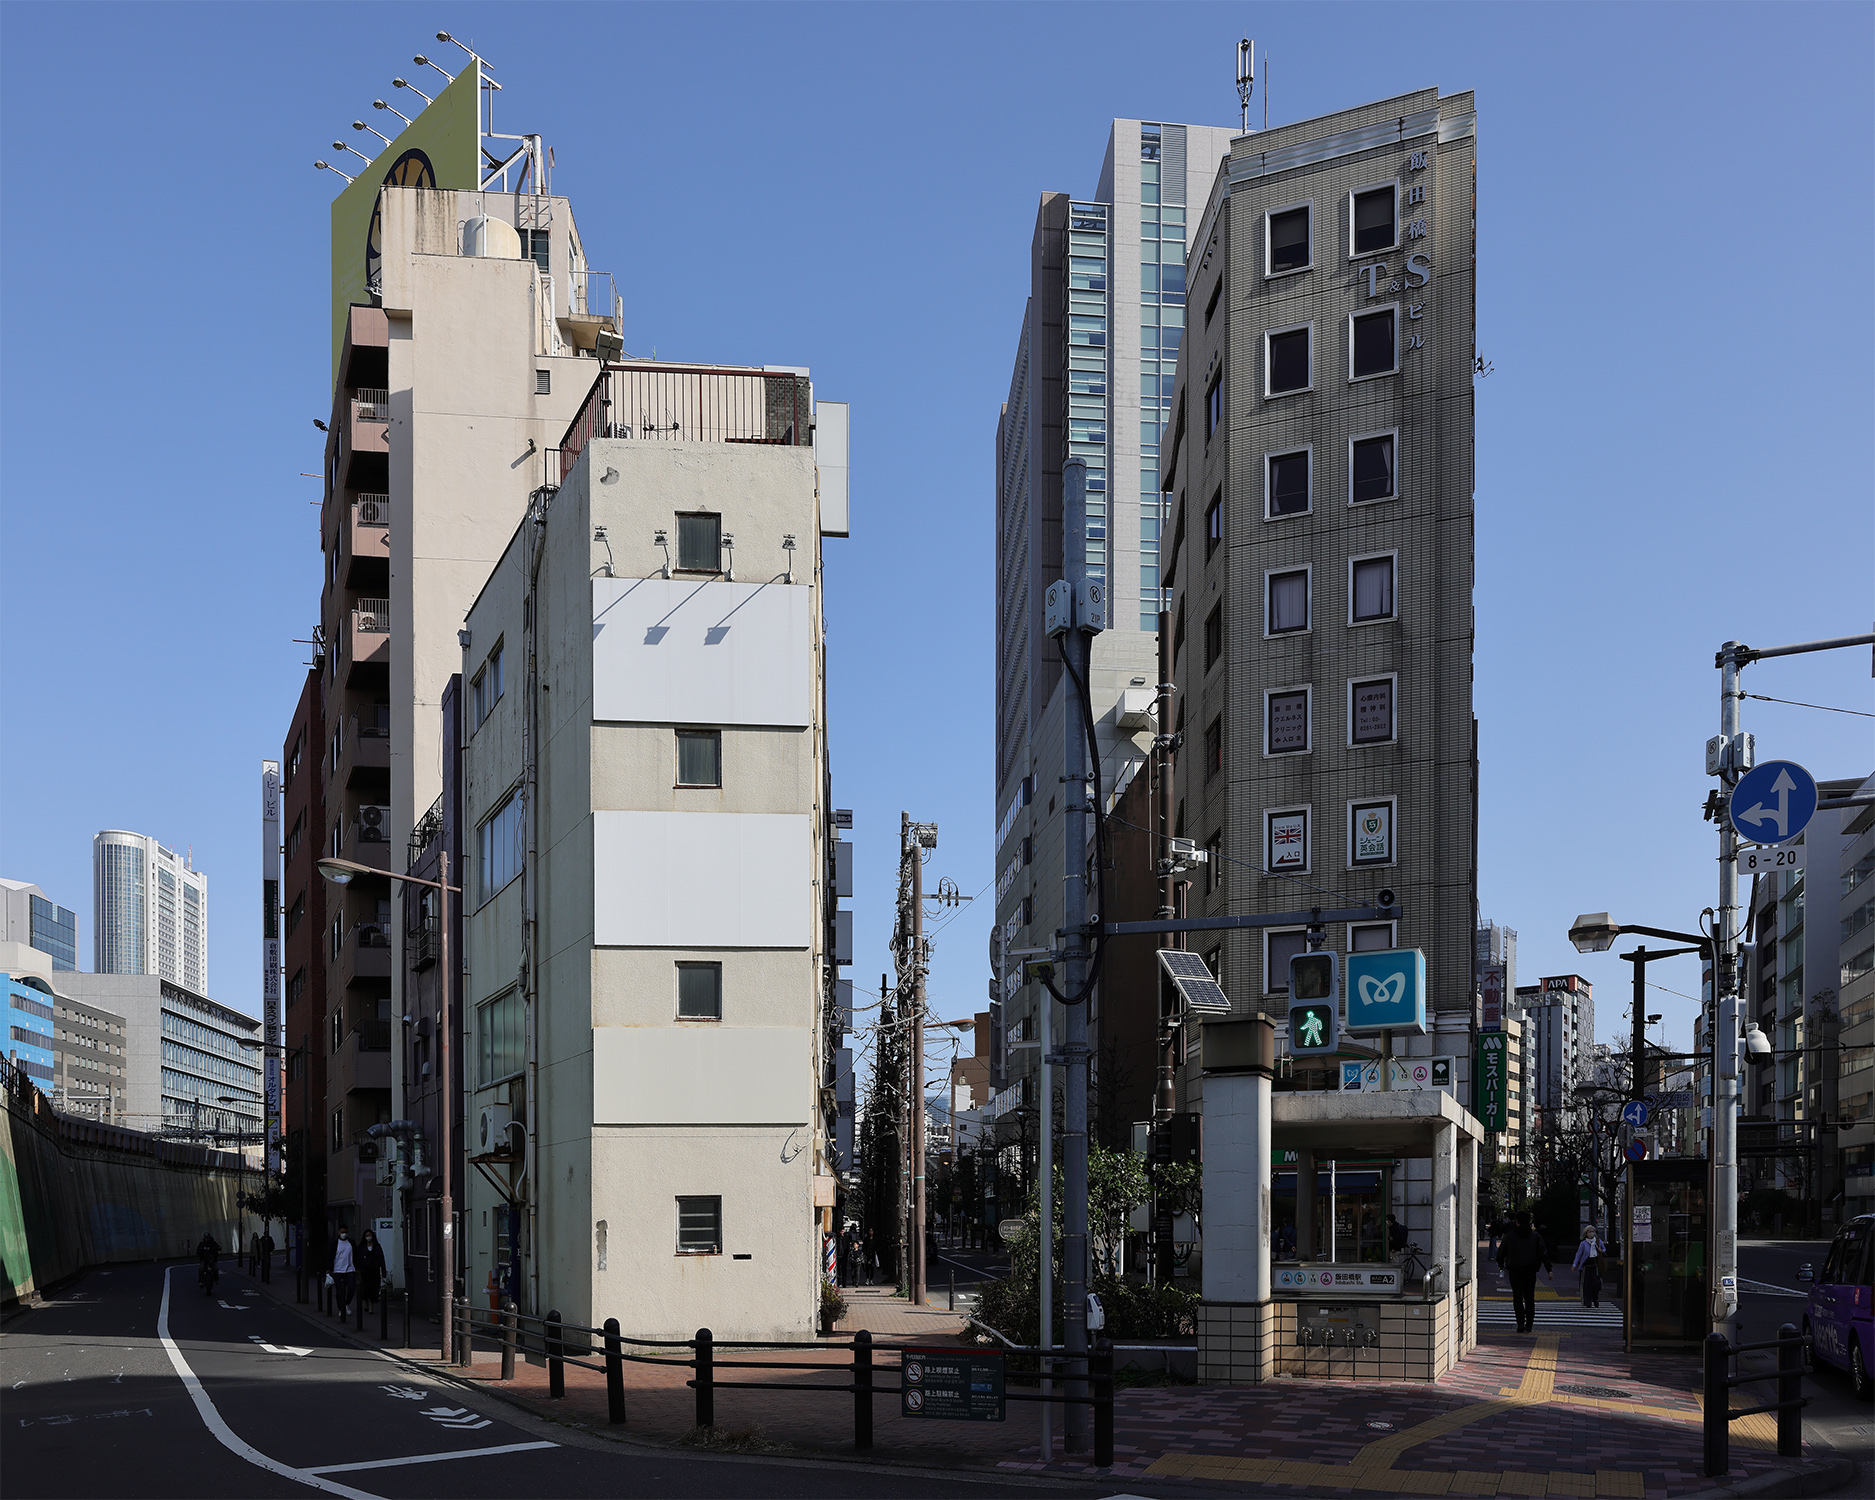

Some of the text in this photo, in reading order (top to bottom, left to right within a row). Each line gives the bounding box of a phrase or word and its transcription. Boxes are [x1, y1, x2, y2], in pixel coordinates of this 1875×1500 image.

[1409, 151, 1428, 240] 飯田橋
[1408, 301, 1427, 350] ビル
[1274, 714, 1302, 723] ウエルネス
[1274, 724, 1302, 733] クリニック
[1360, 835, 1385, 844] シェーン
[1360, 843, 1384, 852] 英会話
[1548, 979, 1568, 989] APA
[1484, 970, 1499, 1022] 不動産
[1485, 1052, 1499, 1128] モスバーガー
[1284, 1151, 1299, 1162] M
[1382, 1275, 1394, 1283] A2
